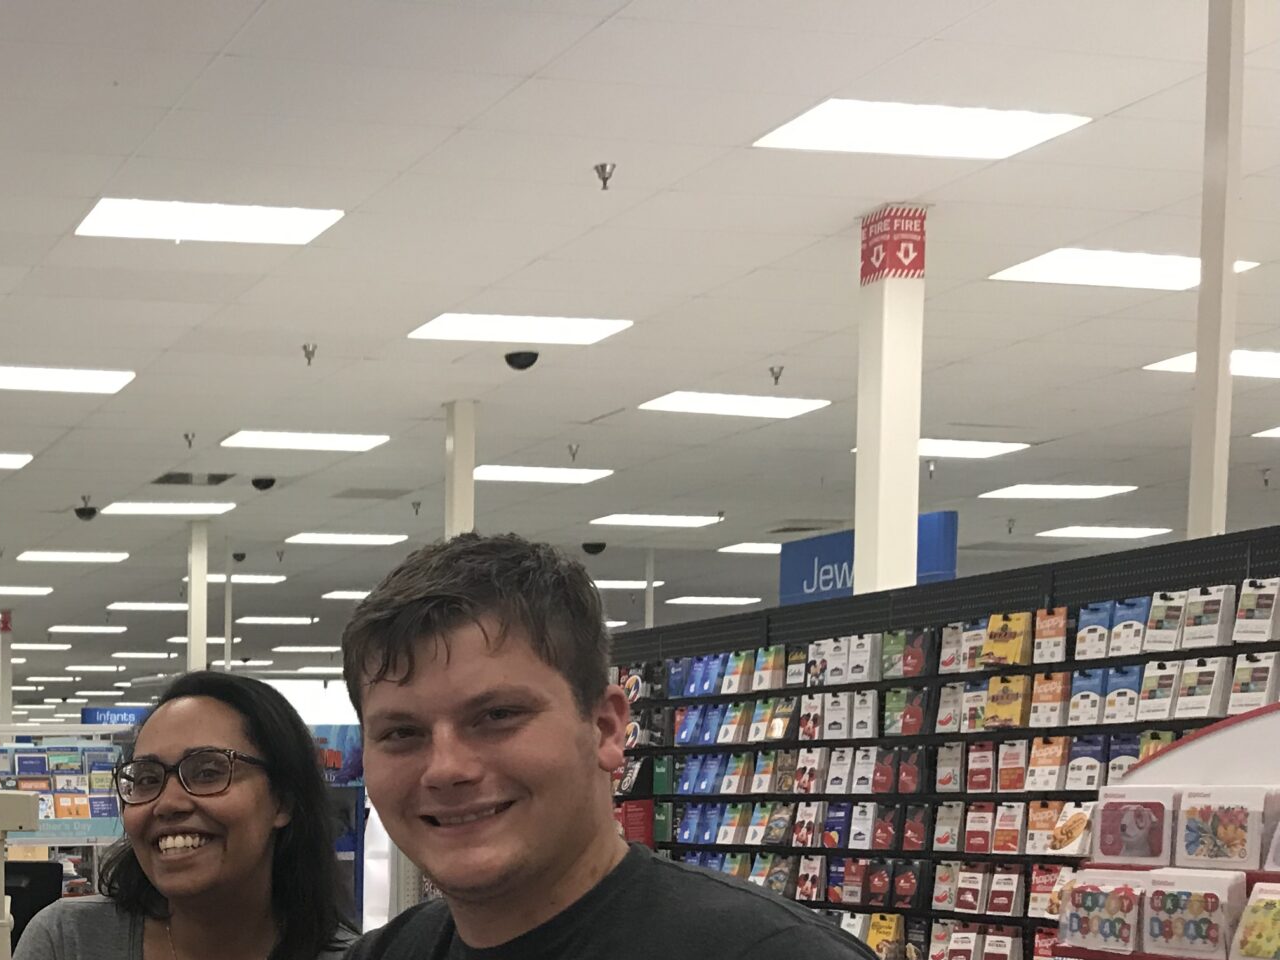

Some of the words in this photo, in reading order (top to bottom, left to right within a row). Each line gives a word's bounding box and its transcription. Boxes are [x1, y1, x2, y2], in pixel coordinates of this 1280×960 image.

[869, 219, 890, 237] FIRE
[893, 219, 921, 232] FIRE
[96, 711, 136, 724] Infants
